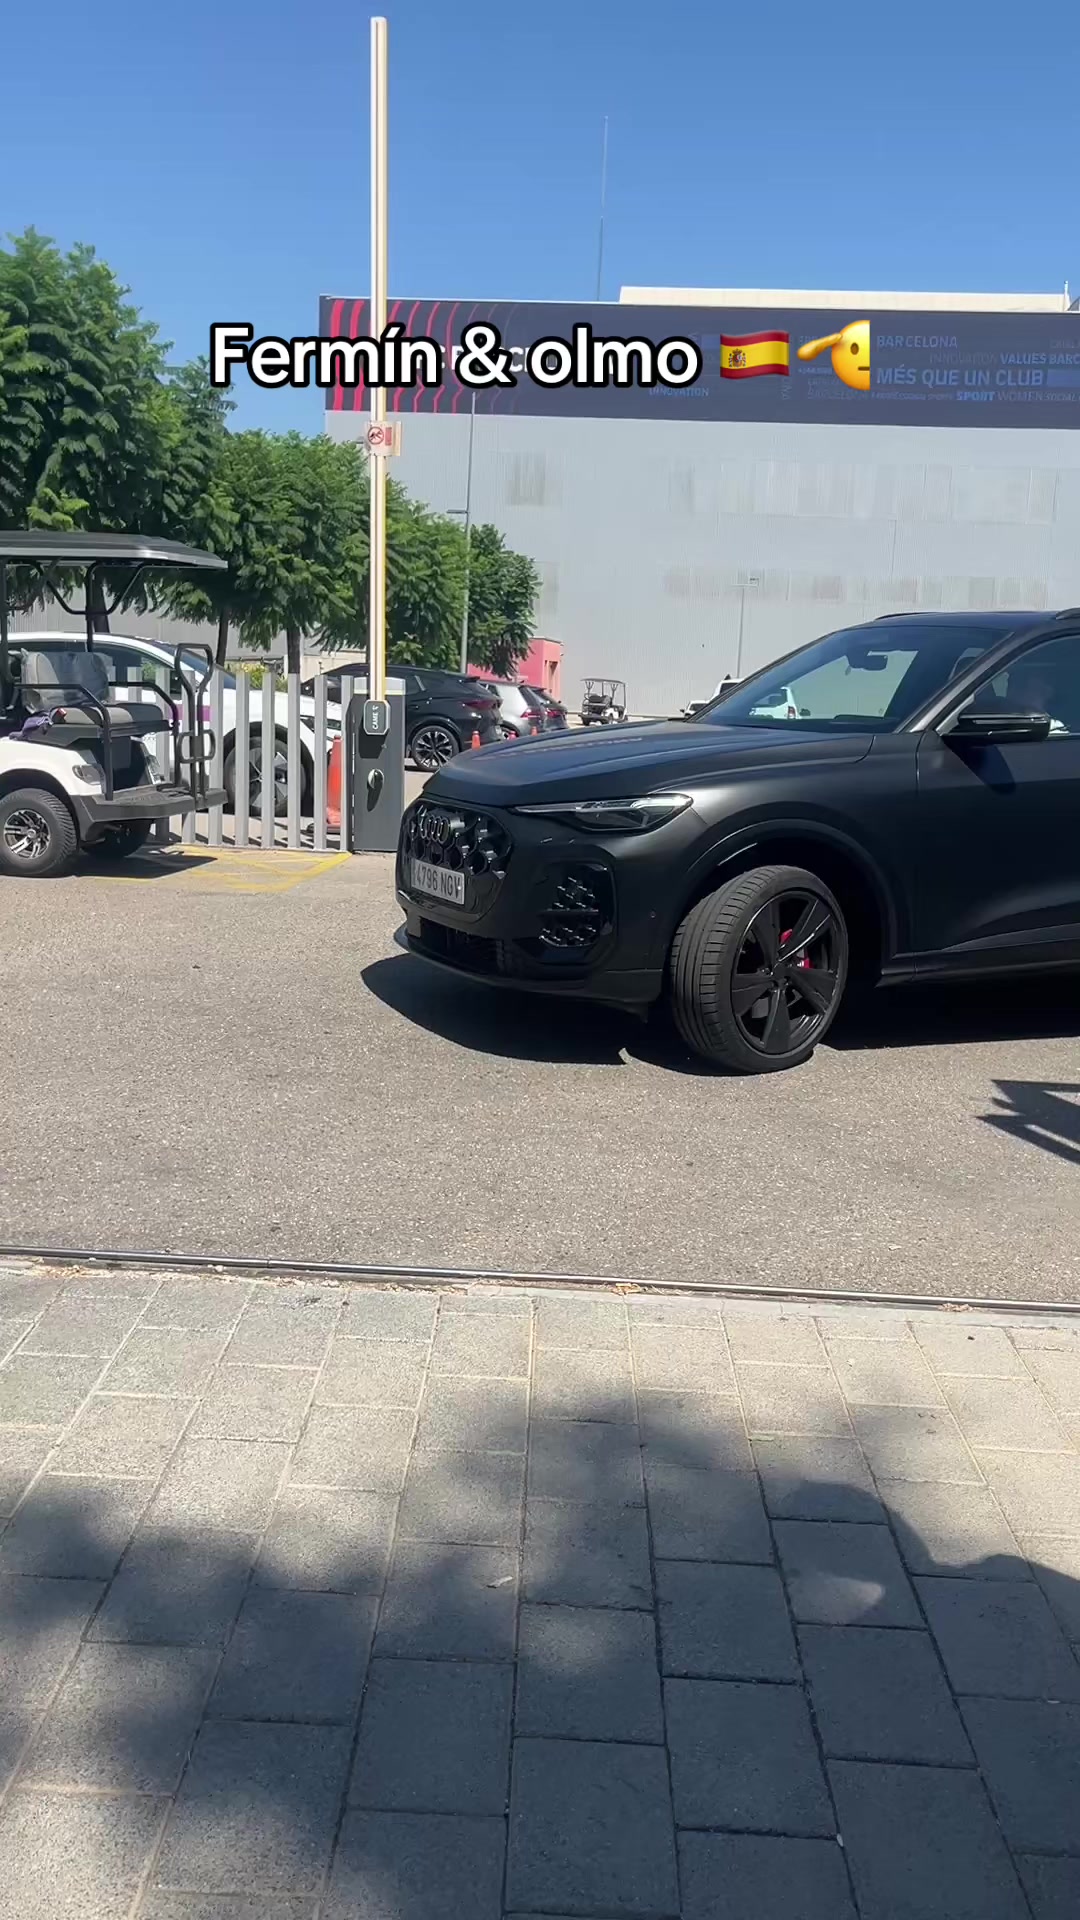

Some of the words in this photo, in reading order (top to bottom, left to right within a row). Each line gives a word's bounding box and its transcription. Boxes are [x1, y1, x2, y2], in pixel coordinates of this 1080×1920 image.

[876, 335, 958, 348] BARCELONA
[1001, 353, 1046, 364] VALUES
[876, 364, 916, 384] MÉS
[921, 369, 960, 388] QUE
[964, 370, 990, 386] UN
[995, 369, 1043, 386] CLUB
[956, 391, 996, 401] SPORT
[371, 711, 380, 730] CAME
[416, 864, 438, 891] 4796
[441, 872, 461, 898] NGV
